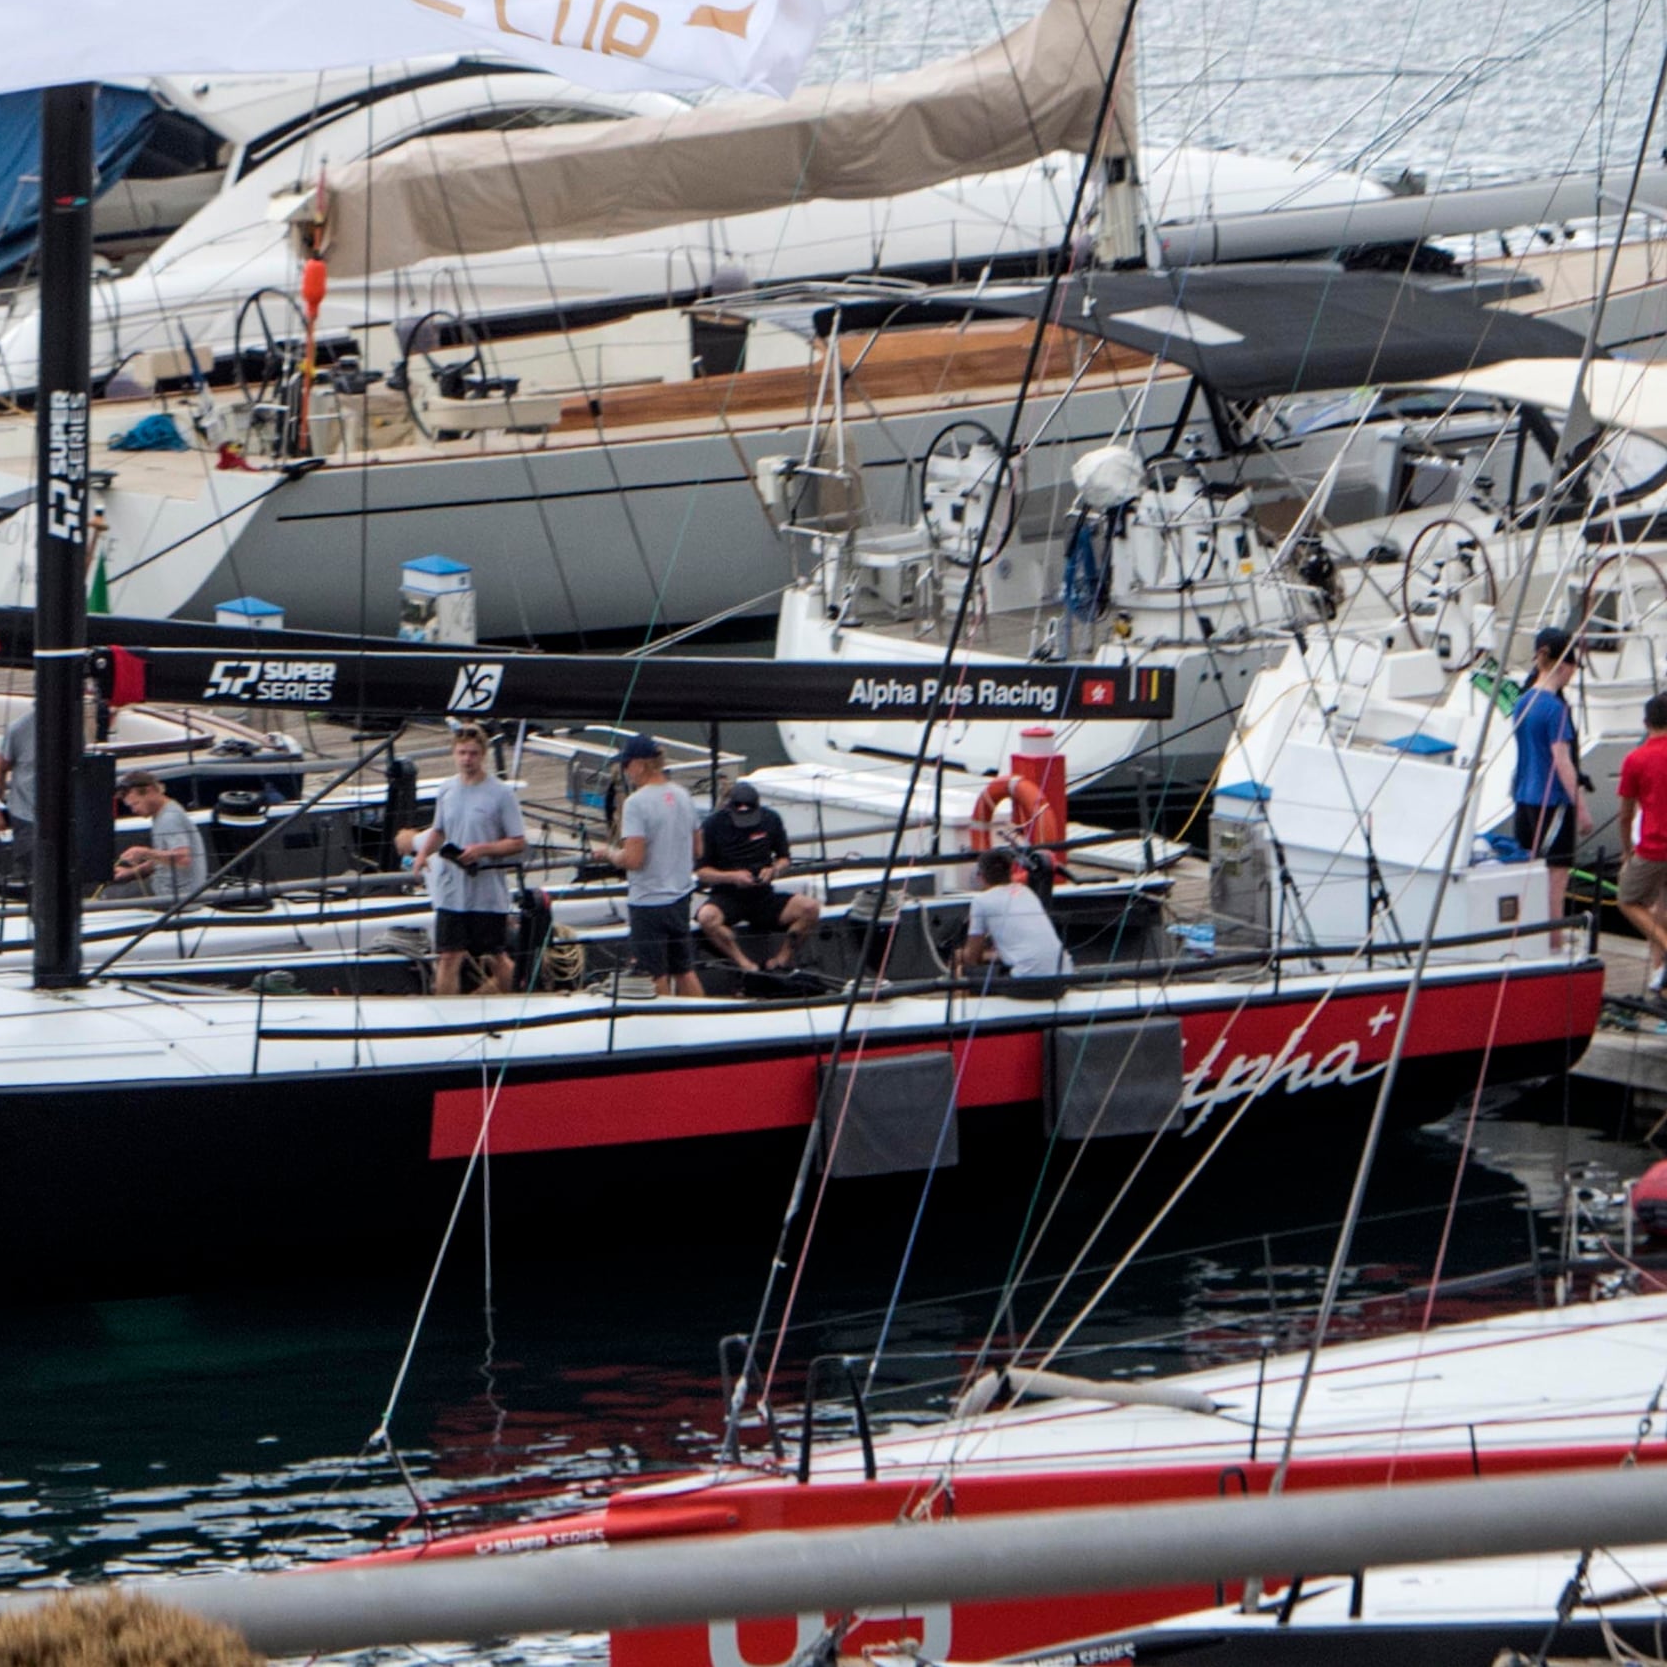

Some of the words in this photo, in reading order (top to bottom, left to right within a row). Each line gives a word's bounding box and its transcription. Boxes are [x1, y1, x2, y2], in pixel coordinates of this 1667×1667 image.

[49, 389, 69, 476] SUPER
[67, 391, 87, 481] SERIES
[47, 479, 85, 544] 52
[202, 661, 263, 700] 52
[262, 661, 337, 682] SUPER
[255, 681, 334, 702] SERIES
[848, 678, 917, 711] Alpha
[978, 679, 1059, 712] Racing
[550, 1528, 605, 1546] SERIES
